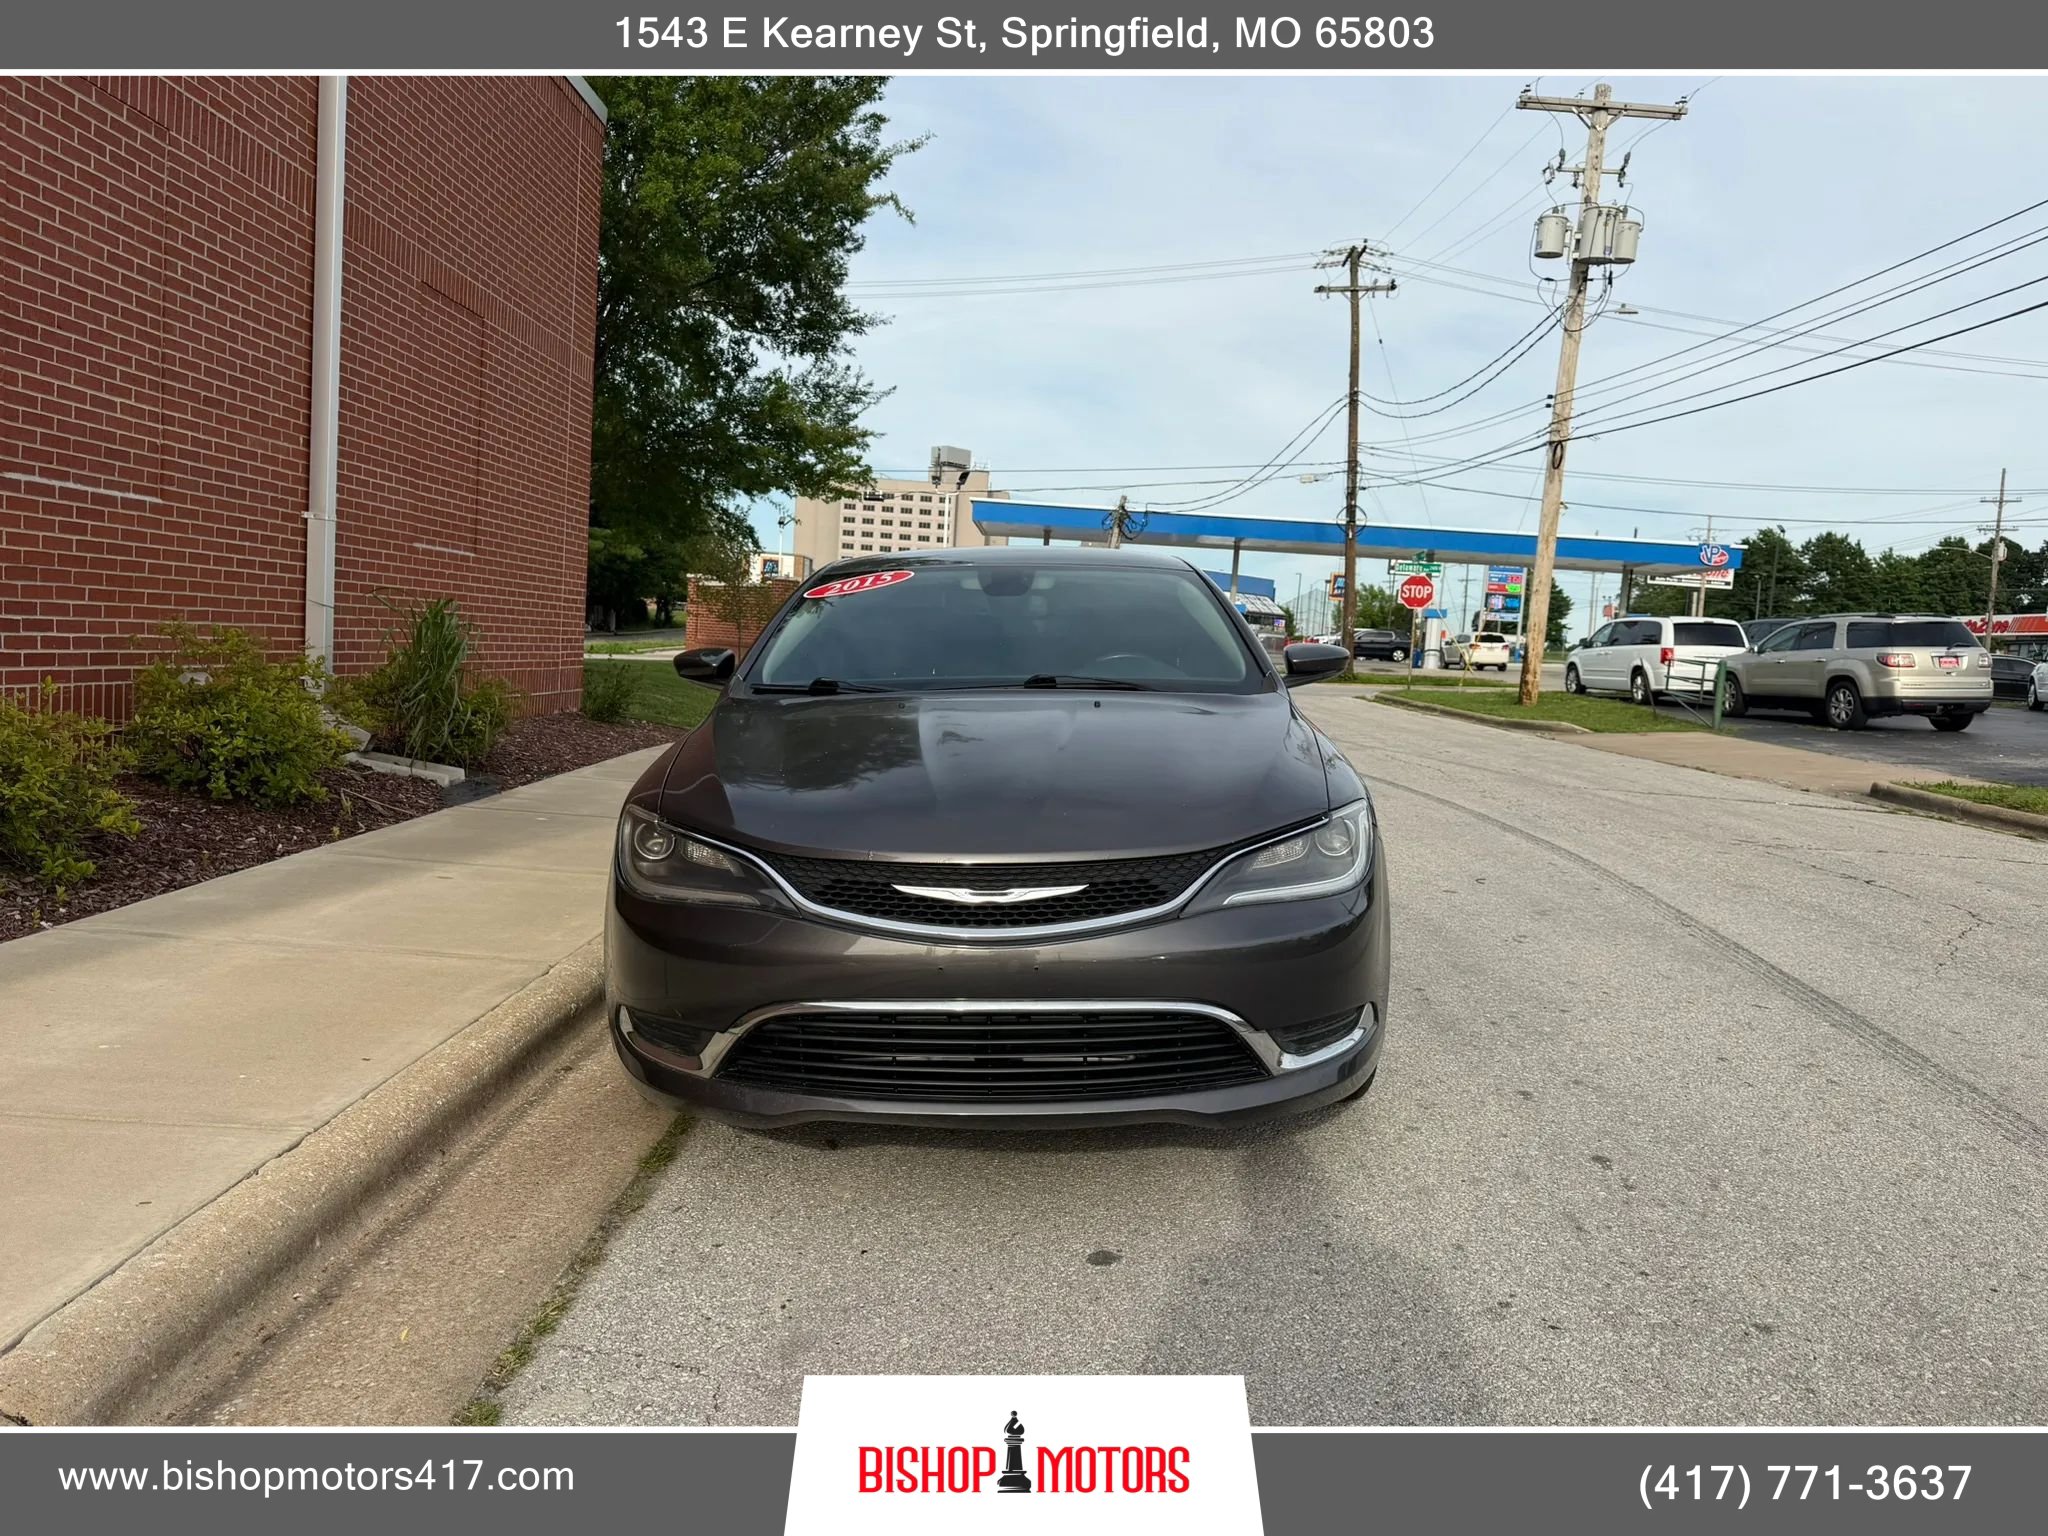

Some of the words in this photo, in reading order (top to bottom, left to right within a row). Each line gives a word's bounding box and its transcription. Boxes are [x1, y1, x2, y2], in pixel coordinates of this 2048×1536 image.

[1702, 544, 1720, 565] VP
[823, 572, 895, 596] 2015
[1401, 584, 1432, 599] STOP
